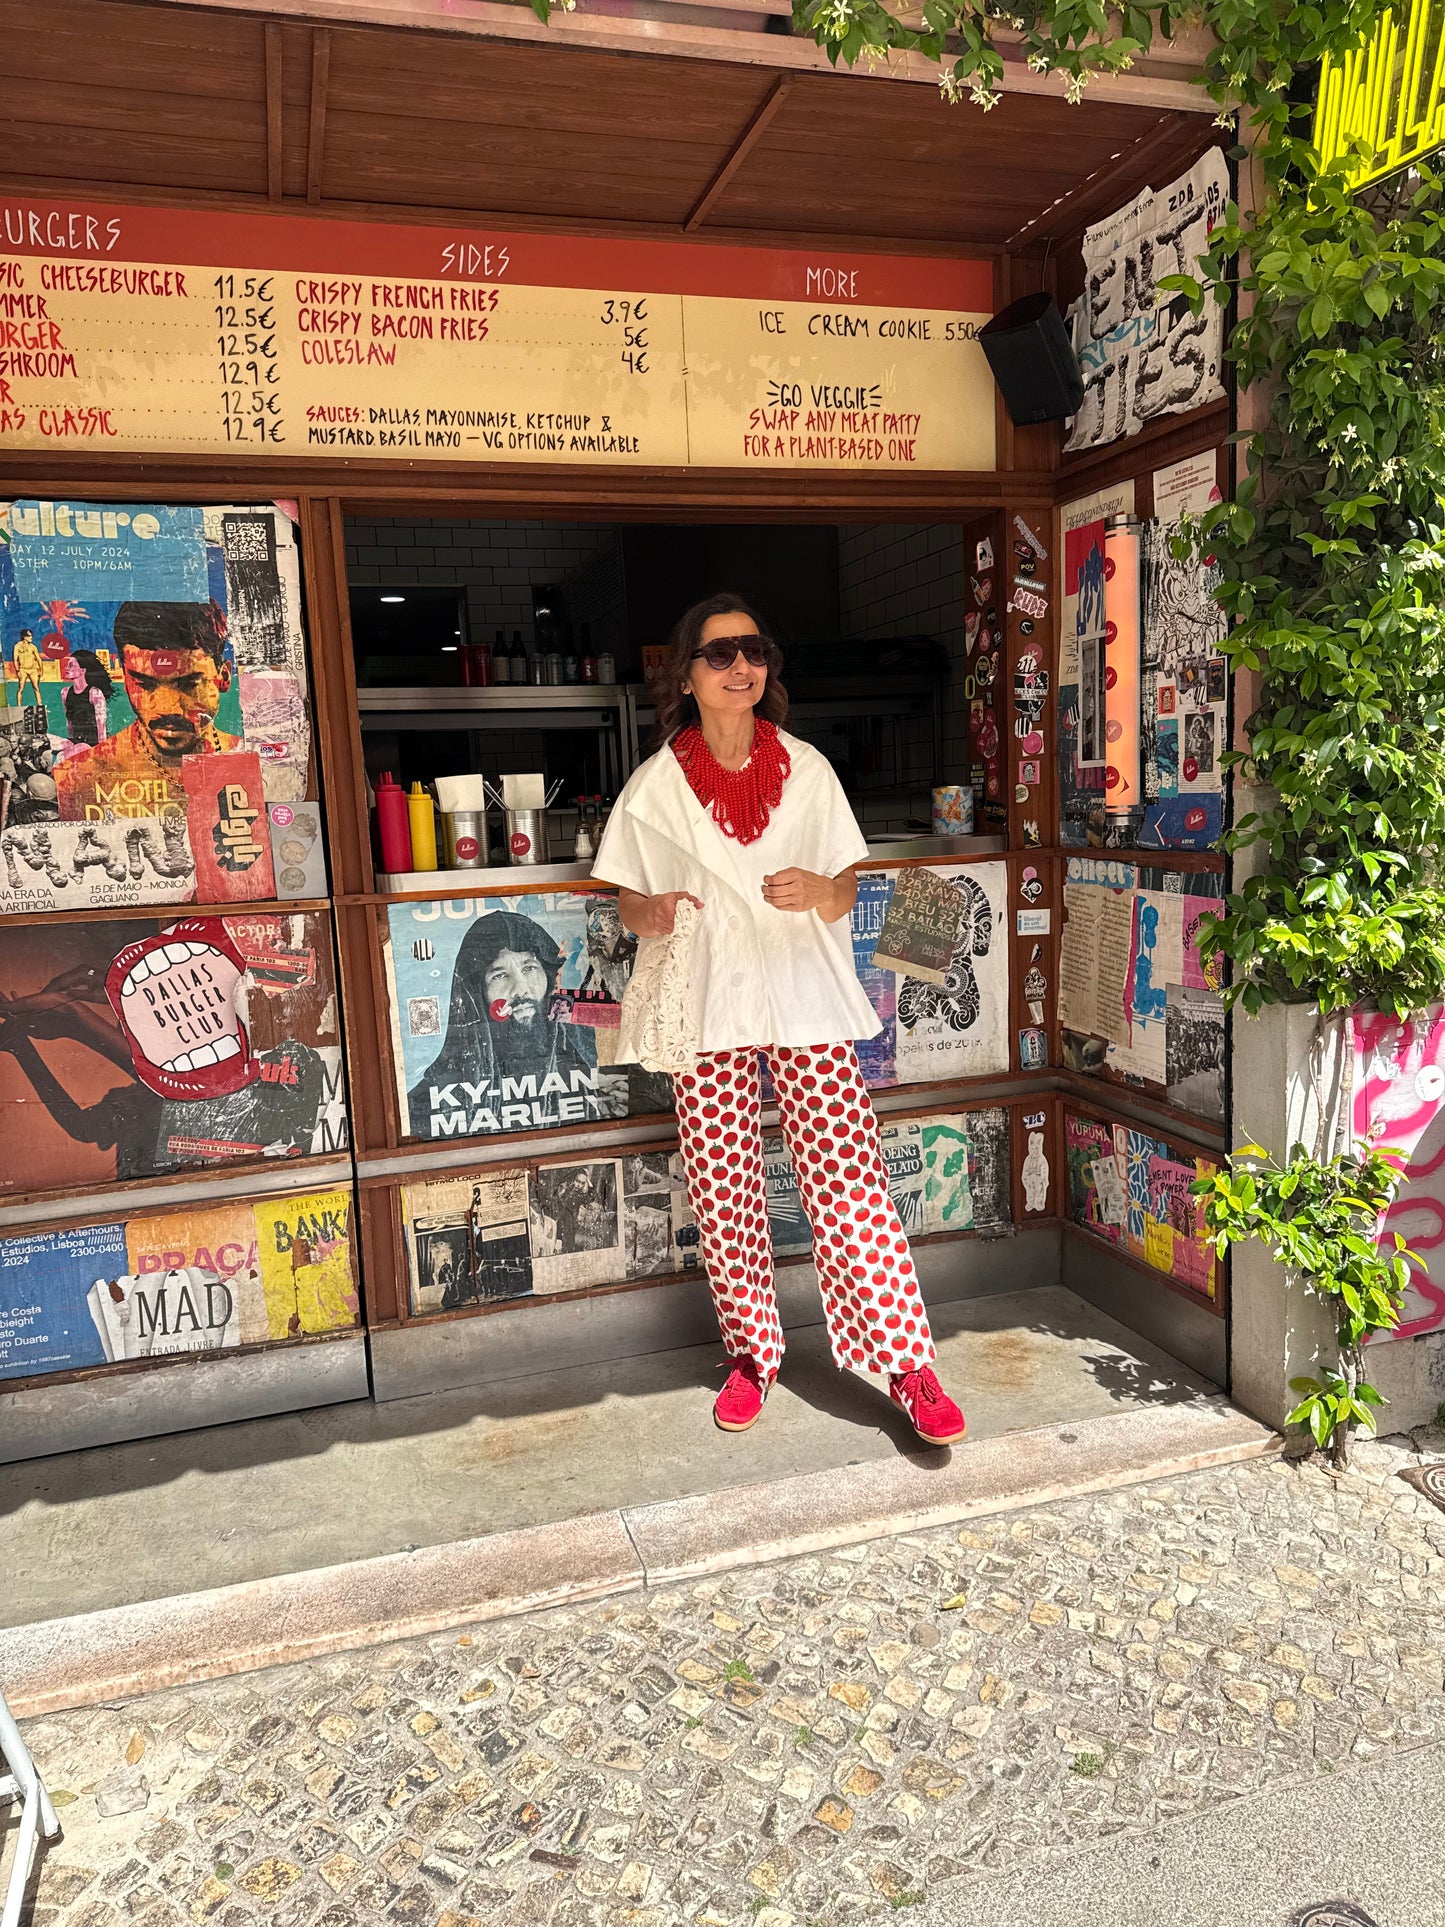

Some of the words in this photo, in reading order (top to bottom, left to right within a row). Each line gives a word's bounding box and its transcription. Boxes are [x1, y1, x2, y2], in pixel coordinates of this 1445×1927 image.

[0, 209, 121, 250] URGERS
[441, 243, 510, 277] SIDES
[41, 264, 189, 298] CHEESEBURGER
[214, 275, 275, 302] 11.5€
[806, 266, 859, 299] MORE
[296, 280, 362, 306] CRISPY
[372, 283, 444, 310] FRENCH
[450, 287, 500, 313] FRIES
[600, 298, 648, 325] 3.9€
[215, 305, 277, 330] 12.5€
[298, 308, 362, 335] CRISPY
[371, 313, 433, 339] BACON
[440, 317, 489, 342] FRIES
[624, 327, 649, 348] 5€
[759, 310, 787, 334] ICE
[808, 314, 869, 338] CREAM
[878, 319, 931, 341] COOKIE
[217, 333, 278, 358] 12.5€
[301, 339, 397, 366] COLESLAW
[621, 351, 650, 375] 4€
[780, 384, 802, 408] GO
[811, 384, 869, 410] VEGGIE
[39, 408, 118, 437] CLASSIC
[306, 405, 365, 423] SAUCES:
[369, 407, 421, 427] DALLAS,
[426, 409, 522, 430] MAYONNAISE,
[526, 413, 591, 431] KETCHUP
[601, 415, 612, 433] &
[749, 408, 800, 431] SWAP
[805, 411, 837, 432] ANY
[841, 412, 880, 433] MEAT
[883, 413, 921, 435] PATTY
[380, 429, 422, 446] BASIL
[425, 430, 461, 447] MAYO
[482, 431, 504, 449] VG
[508, 432, 565, 450] OPTIONS
[570, 435, 640, 454] AVAILABLE
[744, 435, 771, 458] FOR
[774, 436, 785, 458] A
[789, 436, 884, 461] PLANT-BASED
[888, 439, 917, 462] ONE
[41, 546, 55, 555] 12
[101, 547, 131, 558] 2024
[73, 560, 132, 571] 10PM/6AM
[95, 780, 171, 803] MOTEL
[159, 816, 187, 827] LIVRE
[14, 890, 34, 900] ERA
[36, 888, 53, 898] DA
[89, 892, 140, 904] GAGLIANO
[90, 886, 102, 895] 15
[102, 885, 116, 893] DE
[116, 882, 142, 892] MAIO
[150, 879, 188, 890] MONICA
[5, 900, 59, 912] ARTIFICIAL
[142, 963, 213, 1006] DALLAS
[153, 986, 226, 1028] BURGER
[176, 1011, 223, 1044] CLUB
[429, 1068, 600, 1110] KY-MAN
[289, 1202, 312, 1212] THE
[5, 1233, 55, 1247] Collective
[58, 1231, 66, 1239] &
[52, 1239, 85, 1250] Lisboa
[70, 1242, 124, 1258] 2300-0400
[11, 1306, 42, 1317] Costa
[135, 1281, 233, 1339] MAD
[14, 1335, 49, 1347] Duarte
[139, 1345, 181, 1358] ENTRADA
[187, 1339, 215, 1353] LIVRE
